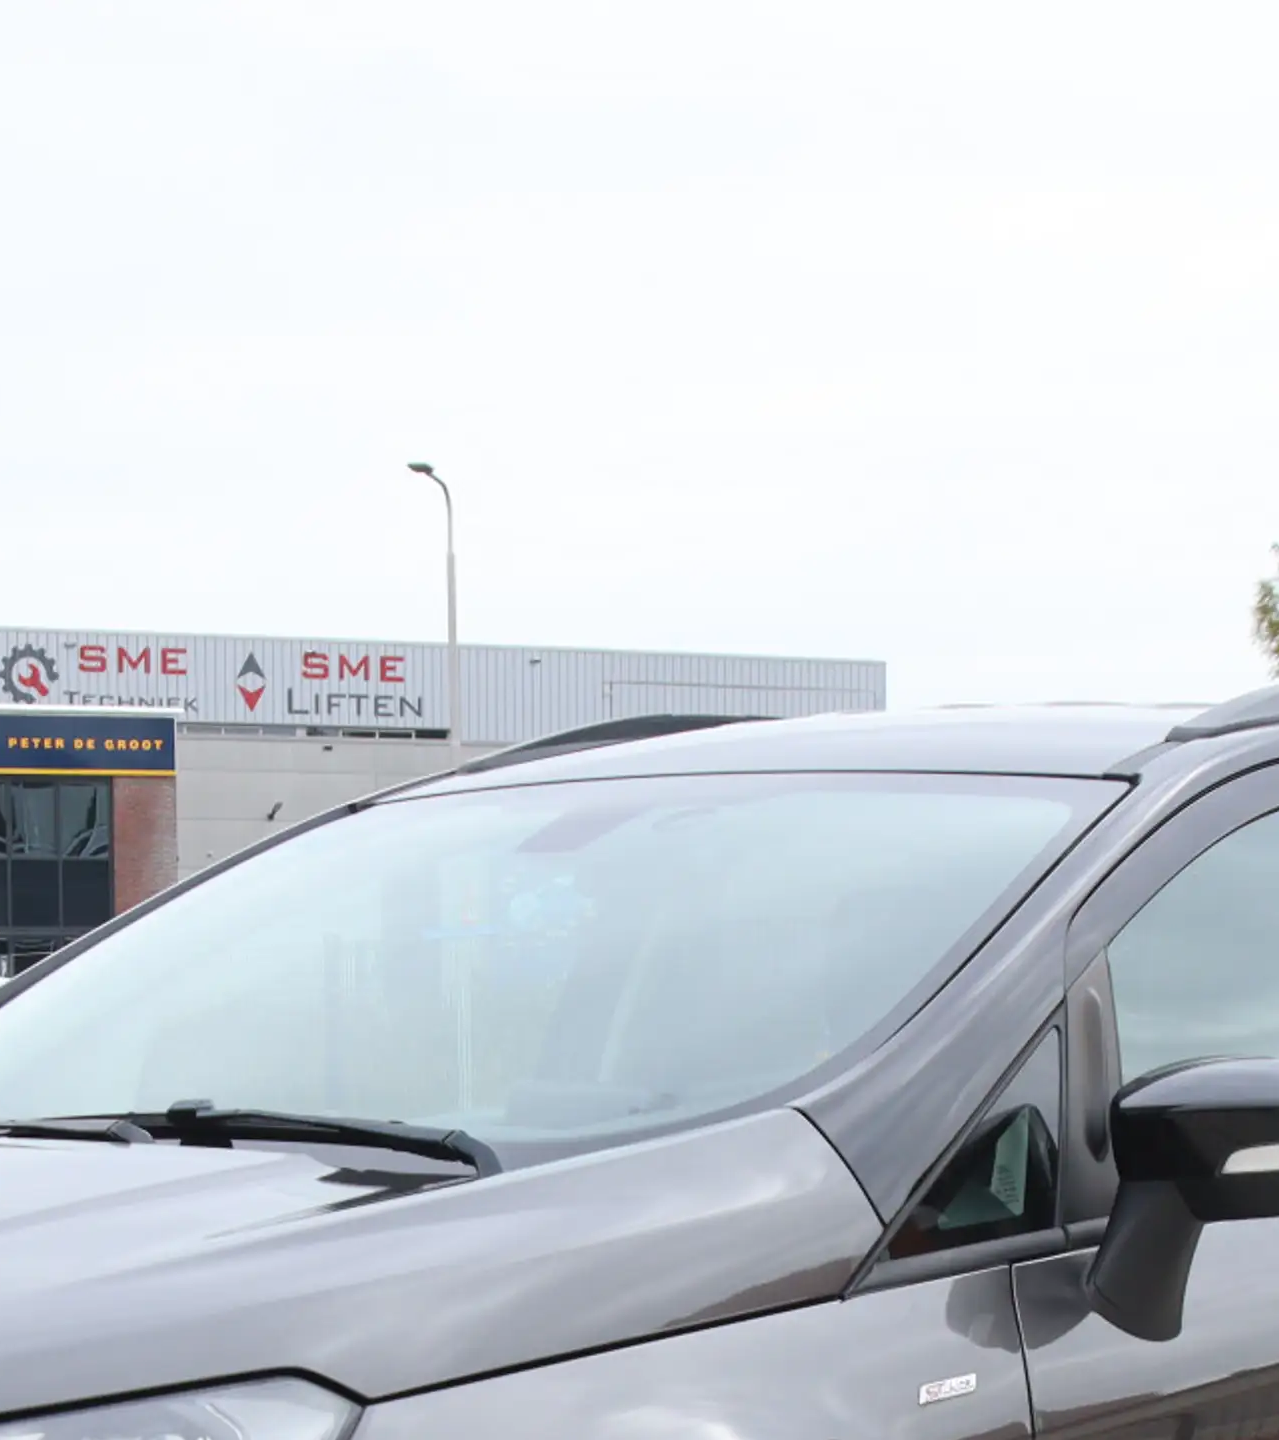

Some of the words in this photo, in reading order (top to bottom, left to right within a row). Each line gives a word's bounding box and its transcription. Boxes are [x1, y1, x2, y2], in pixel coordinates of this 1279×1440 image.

[78, 645, 188, 675] SME
[301, 651, 405, 682] SME
[7, 737, 65, 749] PETER
[73, 738, 96, 750] DE
[104, 738, 164, 751] GROOT
